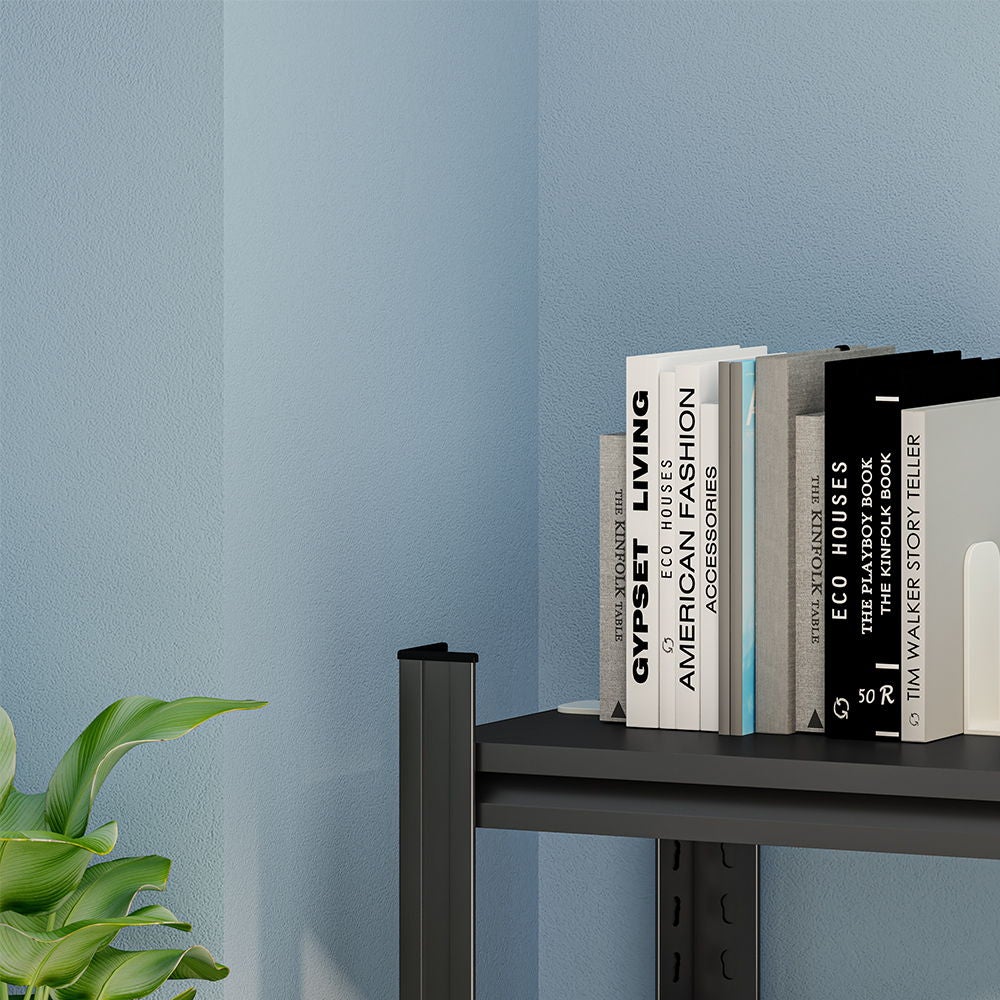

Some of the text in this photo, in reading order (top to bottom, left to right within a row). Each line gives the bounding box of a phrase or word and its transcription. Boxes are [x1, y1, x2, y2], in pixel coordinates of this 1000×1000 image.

[614, 488, 625, 643] THE KINFOLK TABLE
[632, 390, 649, 684] GYPSET LIVING
[660, 459, 673, 579] ECO HOUSES
[679, 388, 696, 692] AMERICAN FASHION
[705, 466, 718, 614] ACCESSORIES
[811, 474, 823, 645] THE KINFOLK TABLE
[831, 461, 848, 620] ECO HOUSES
[861, 457, 873, 635] THE PLAYBOY BOOK
[880, 452, 892, 616] THE KINFOLK BOOK
[906, 434, 921, 701] TIM WALKER STORY TELLER
[858, 688, 876, 704] 50
